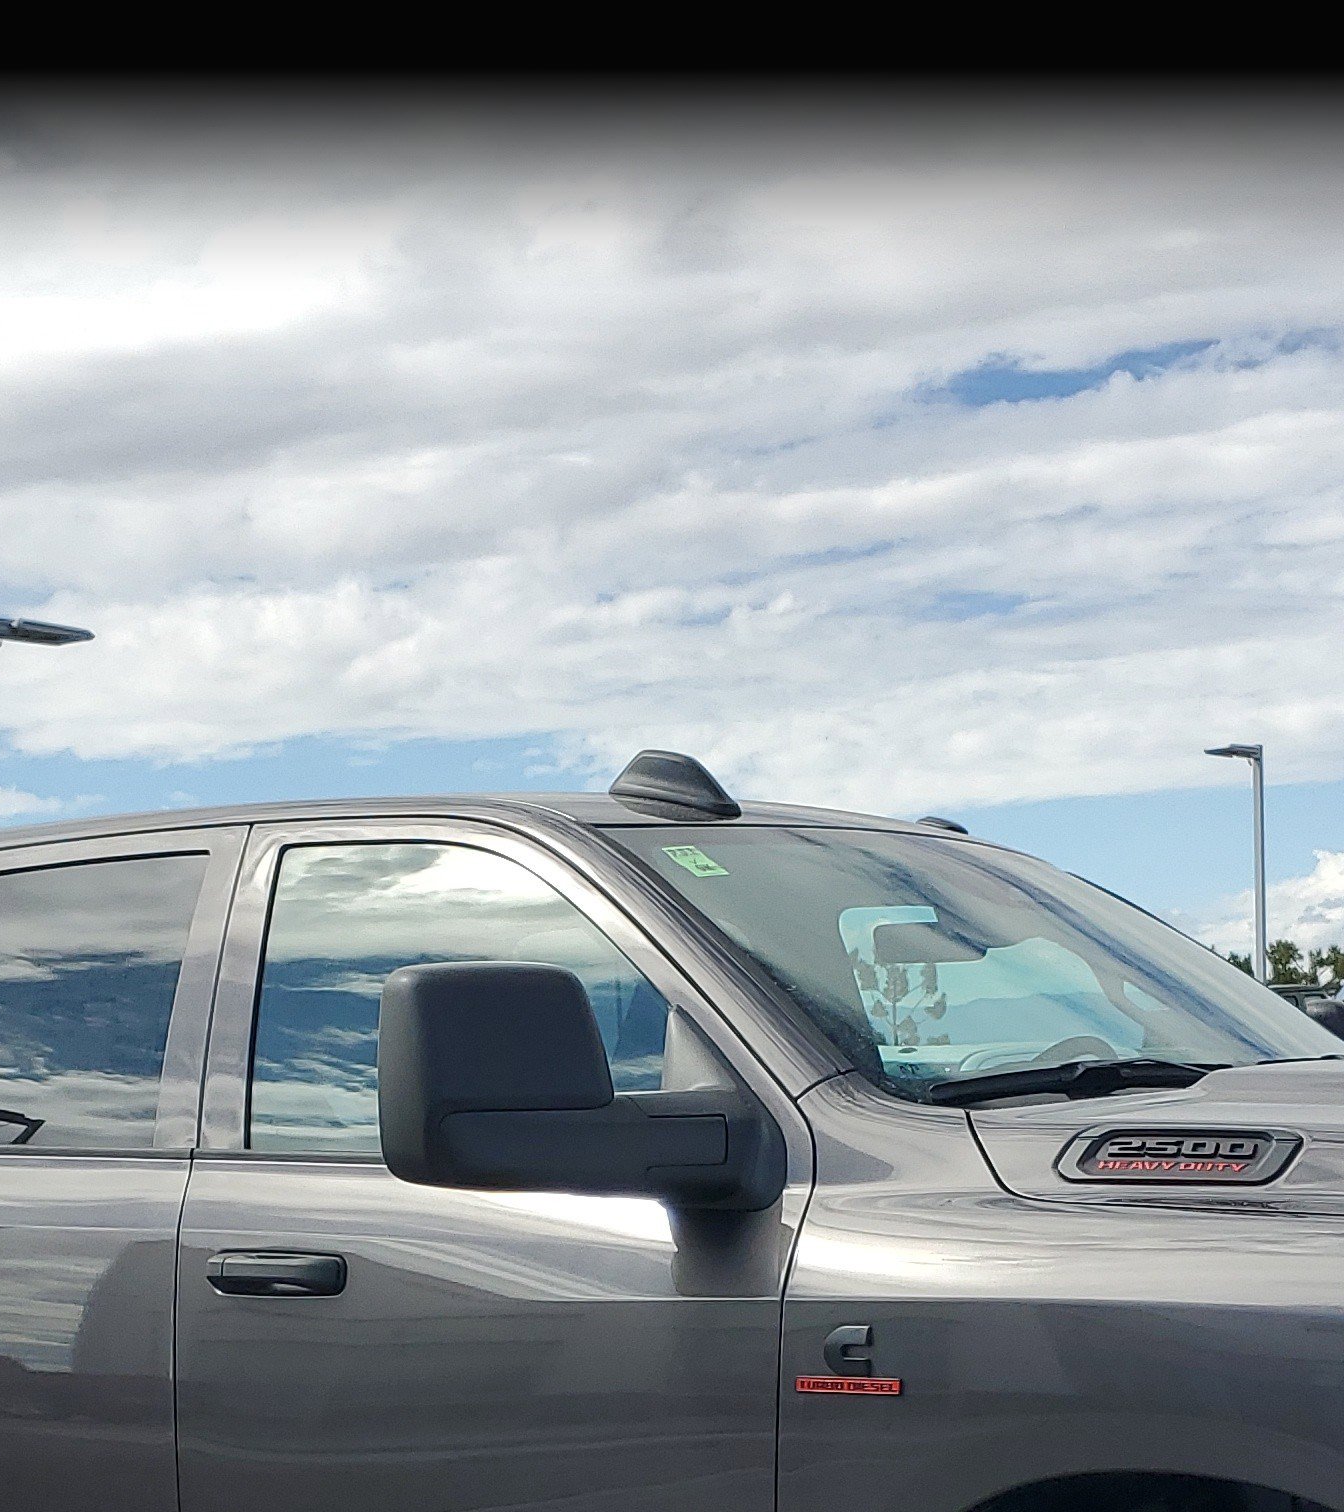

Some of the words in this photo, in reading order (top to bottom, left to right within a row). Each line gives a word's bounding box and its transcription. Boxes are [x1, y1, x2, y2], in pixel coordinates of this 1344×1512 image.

[1106, 1139, 1258, 1159] 2500
[1097, 1160, 1175, 1171] HEAVY
[1178, 1161, 1250, 1173] DUTY
